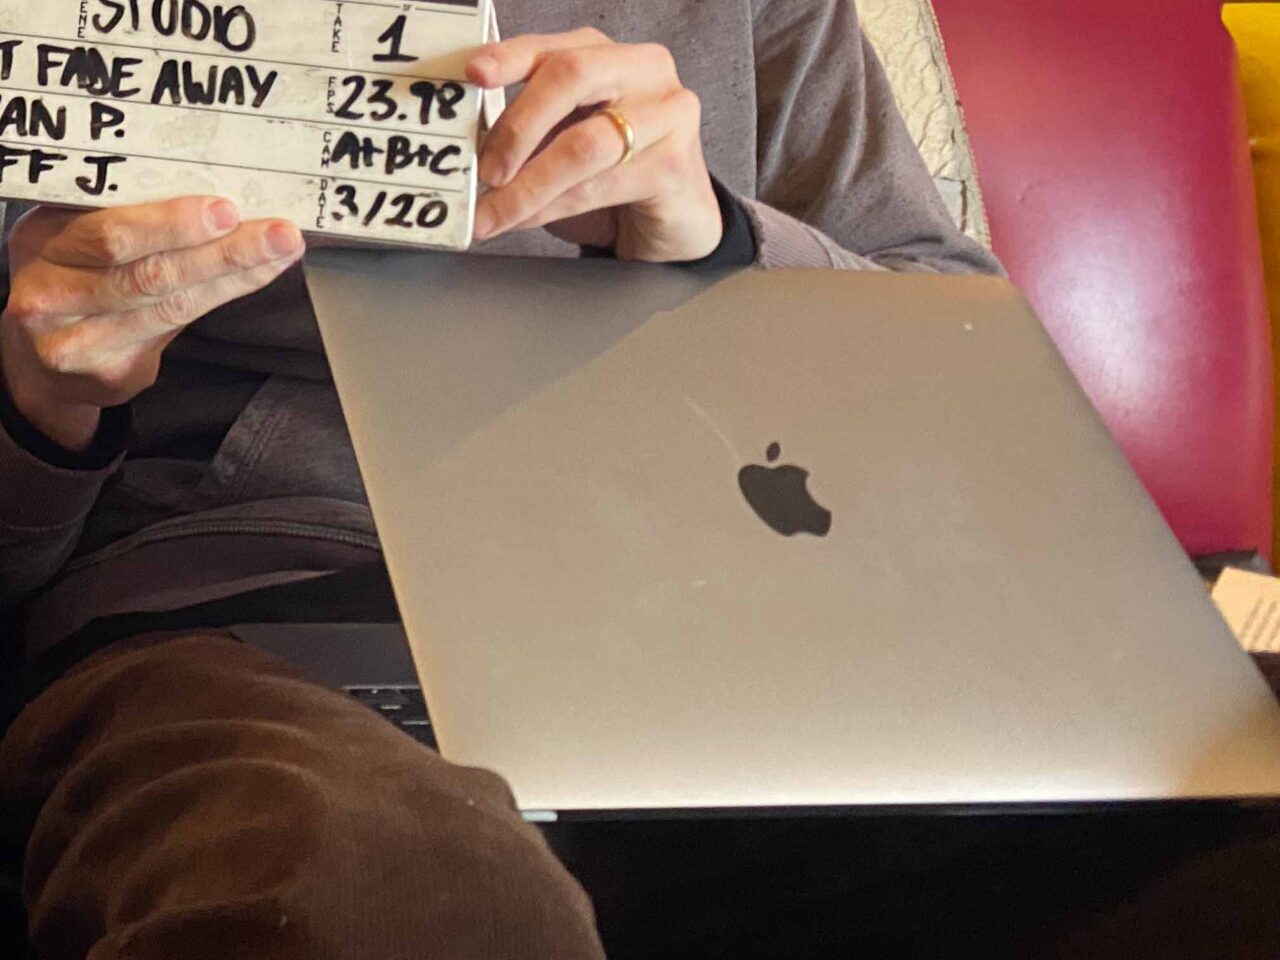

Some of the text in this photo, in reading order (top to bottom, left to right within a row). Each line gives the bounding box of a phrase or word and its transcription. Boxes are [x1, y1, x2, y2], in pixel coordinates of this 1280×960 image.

[330, 3, 343, 53] TAKE
[372, 14, 419, 62] 1
[150, 59, 278, 109] AWAY
[327, 77, 337, 114] FPS
[334, 75, 466, 125] 23.98
[90, 101, 125, 141] P.
[321, 131, 333, 168] CAM
[75, 155, 127, 196] J.
[316, 179, 328, 229] DATE
[331, 184, 449, 228] 3/20
